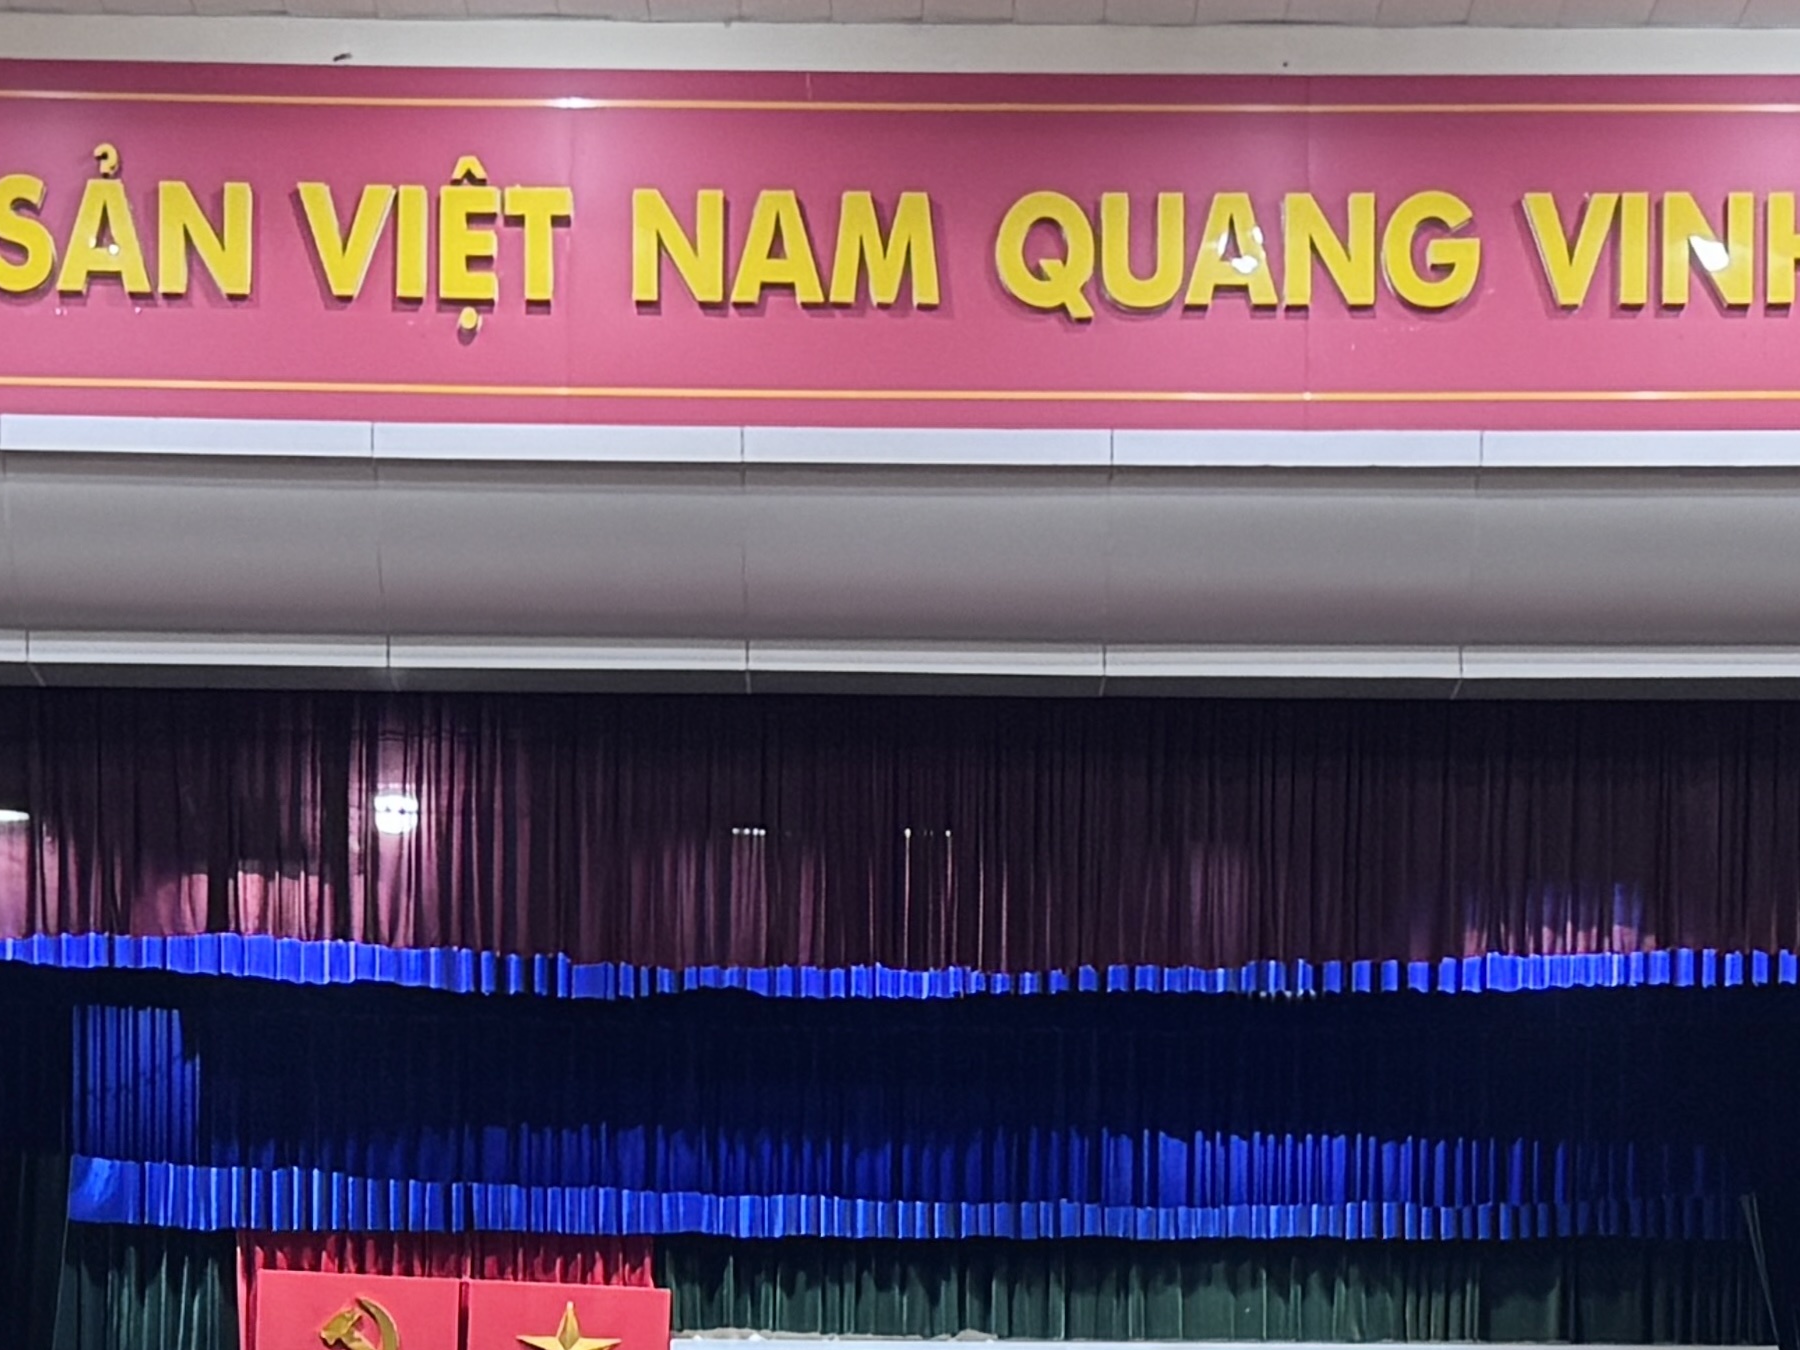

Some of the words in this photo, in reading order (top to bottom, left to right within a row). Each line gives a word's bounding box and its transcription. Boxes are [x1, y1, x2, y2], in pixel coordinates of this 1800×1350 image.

[296, 152, 574, 337] VIỆT
[633, 184, 942, 309] NAM
[992, 187, 1483, 312] QUANG
